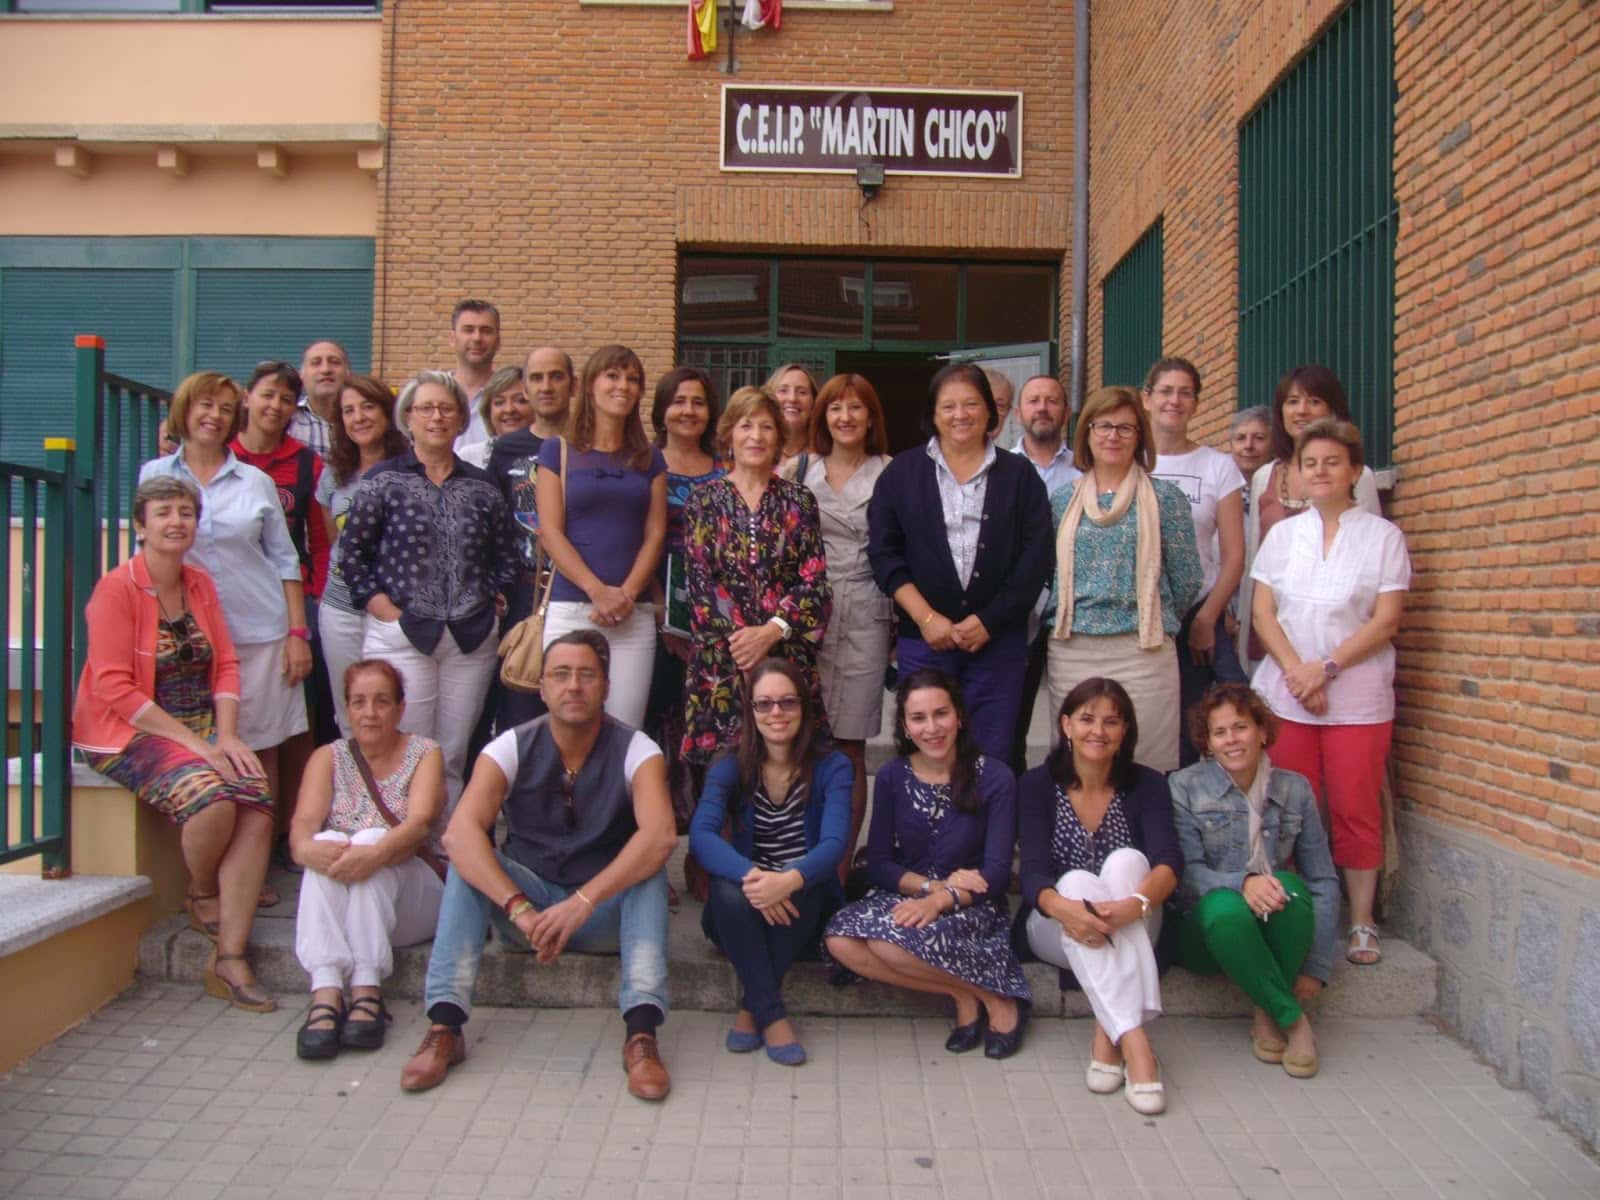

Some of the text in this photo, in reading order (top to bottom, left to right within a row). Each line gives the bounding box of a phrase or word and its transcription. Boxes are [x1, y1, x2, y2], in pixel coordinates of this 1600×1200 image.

[736, 103, 1007, 160] C.E.I.P. "MARTIN CHICO"
